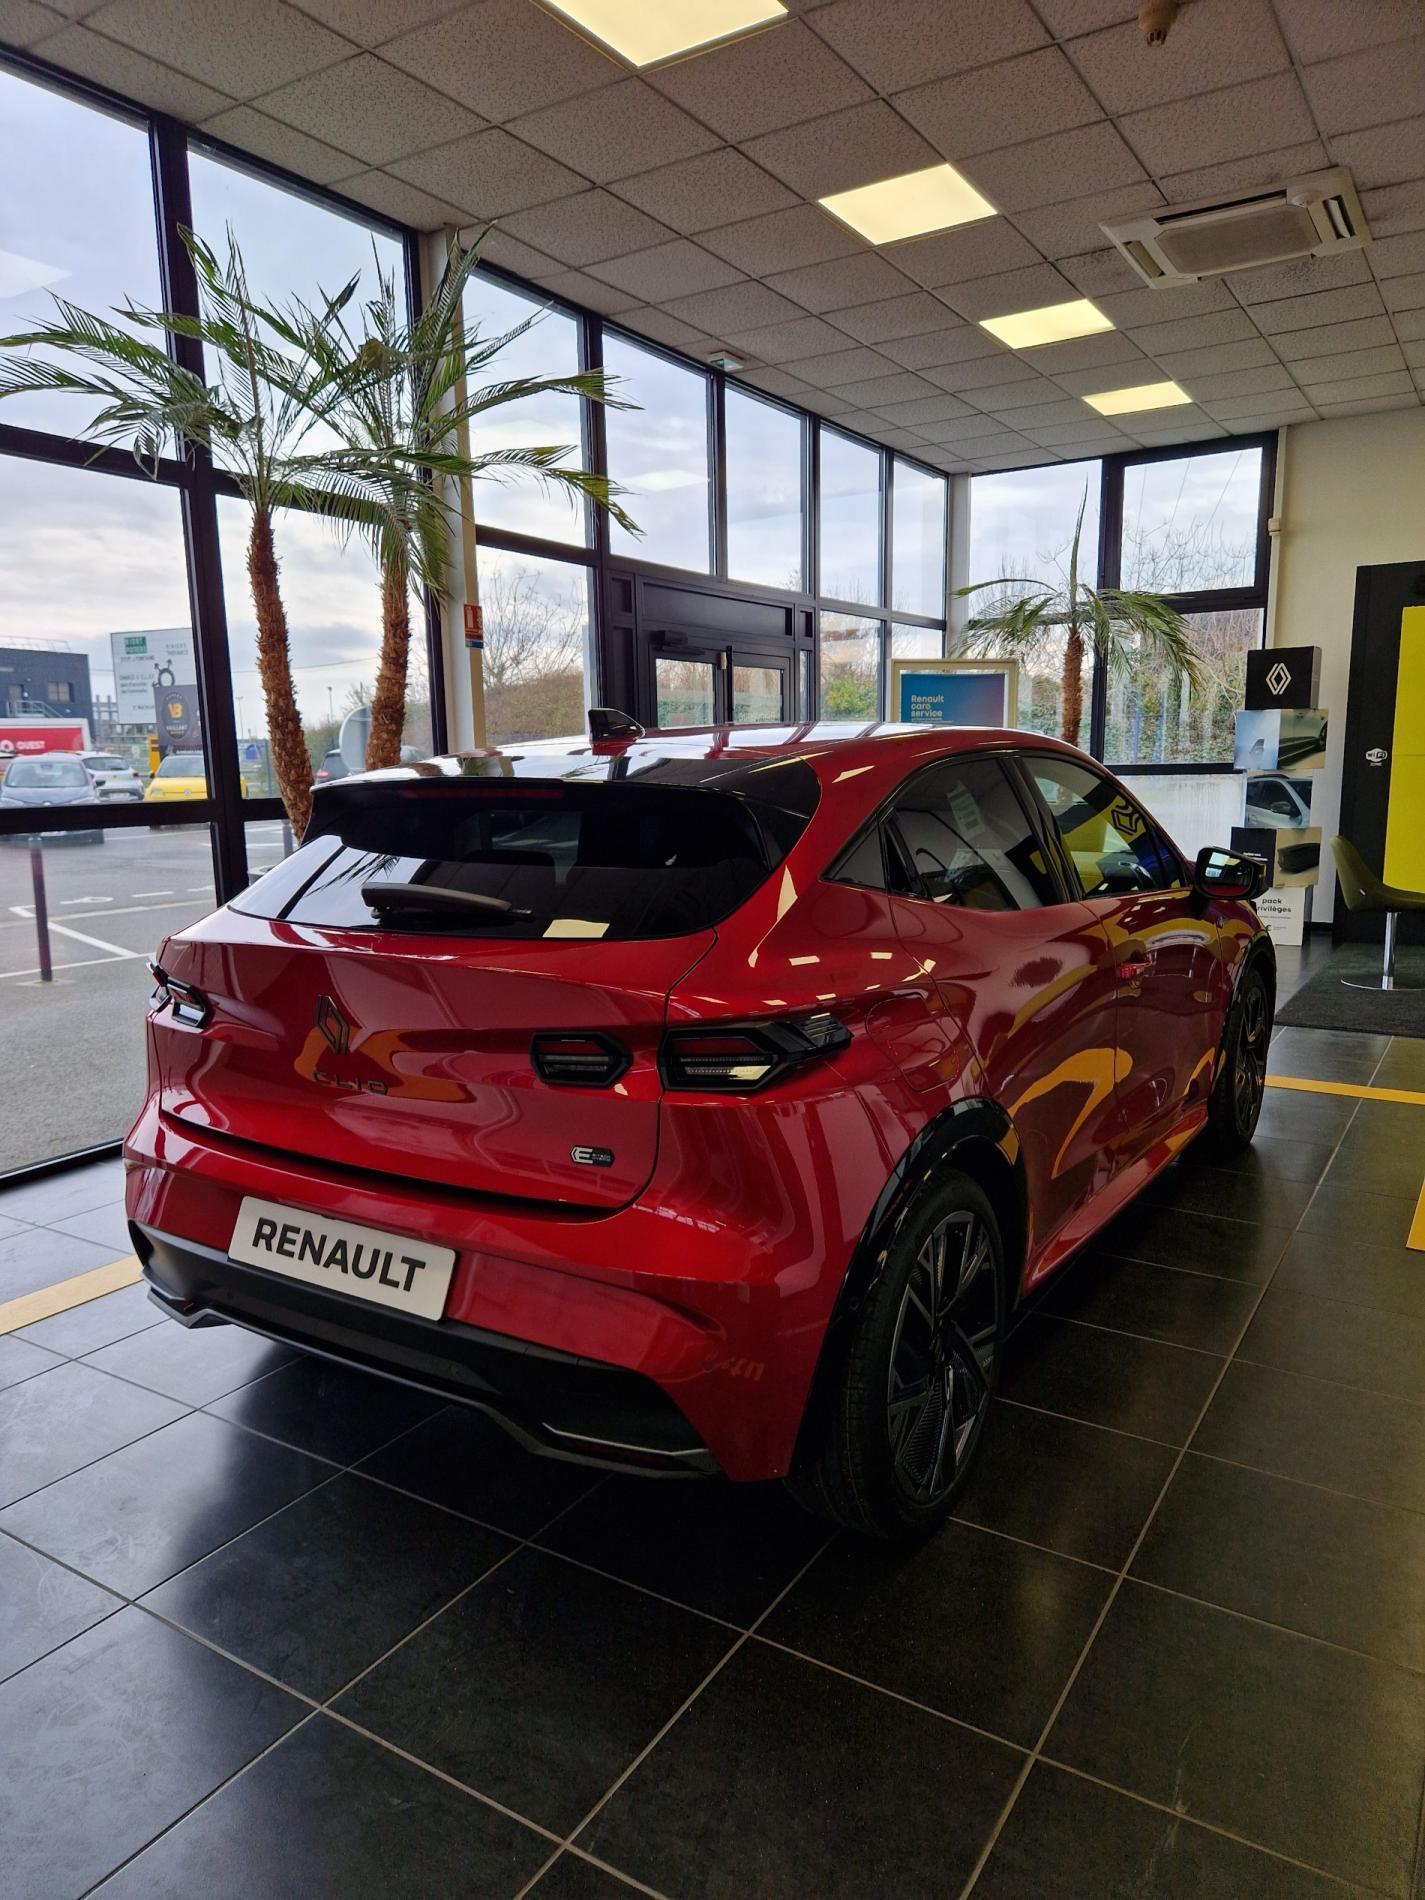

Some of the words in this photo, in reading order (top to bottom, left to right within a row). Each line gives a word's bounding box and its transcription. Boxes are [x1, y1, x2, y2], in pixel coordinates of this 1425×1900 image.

[911, 694, 945, 703] Renault
[1256, 903, 1292, 914] rivilèges
[313, 1071, 388, 1095] CLIO
[252, 1216, 426, 1292] RENAULT
